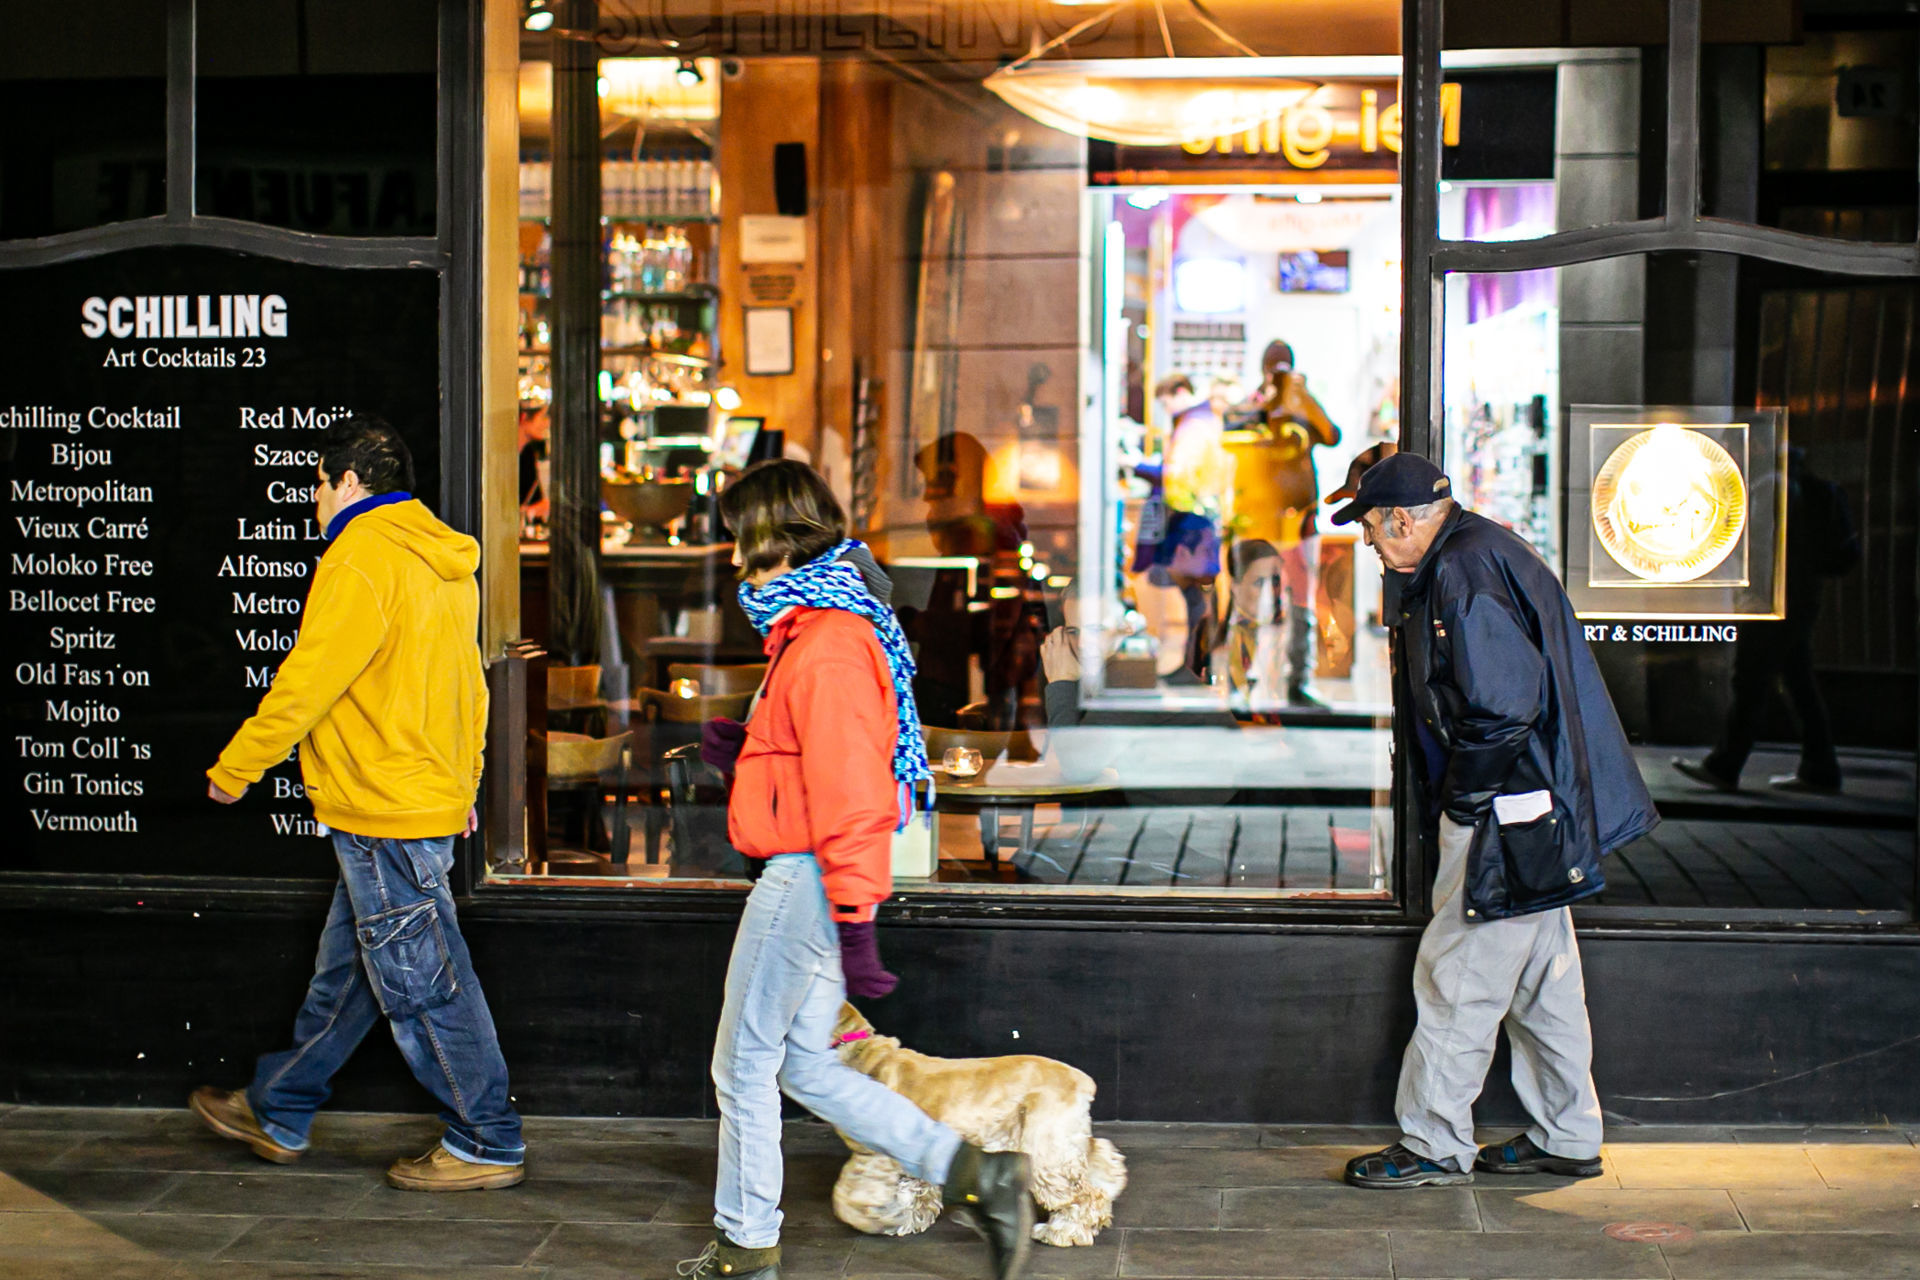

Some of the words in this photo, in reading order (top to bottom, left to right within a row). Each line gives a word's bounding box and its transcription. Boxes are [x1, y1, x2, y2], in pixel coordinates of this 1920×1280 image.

[82, 295, 287, 338] SCHILLING
[103, 348, 136, 367] Art
[143, 347, 236, 367] Cocktails
[242, 347, 266, 367] 23
[0, 406, 81, 434] chilling
[88, 406, 180, 428] Cocktail
[240, 407, 284, 428] Red
[52, 443, 111, 471] Bijou
[11, 480, 152, 507] Metropolitan
[16, 516, 80, 538] Vieux
[88, 517, 148, 539] Carré
[238, 518, 296, 540] Latin
[13, 553, 97, 575] Moloko
[105, 554, 153, 576] Free
[218, 555, 307, 577] Alfonso
[10, 590, 99, 612] Bellocet
[108, 591, 155, 612] Free
[233, 592, 300, 614] Metro
[51, 627, 115, 654] Spritz
[1611, 624, 1628, 642] &
[1633, 625, 1737, 642] SCHILLING
[16, 663, 56, 684] Old
[64, 664, 149, 686] Fason
[47, 700, 119, 727] Mojito
[16, 736, 64, 757] Tom
[73, 737, 151, 759] Collns
[24, 773, 64, 793] Gin
[71, 774, 143, 795] Tonics
[31, 809, 137, 832] Vermouth
